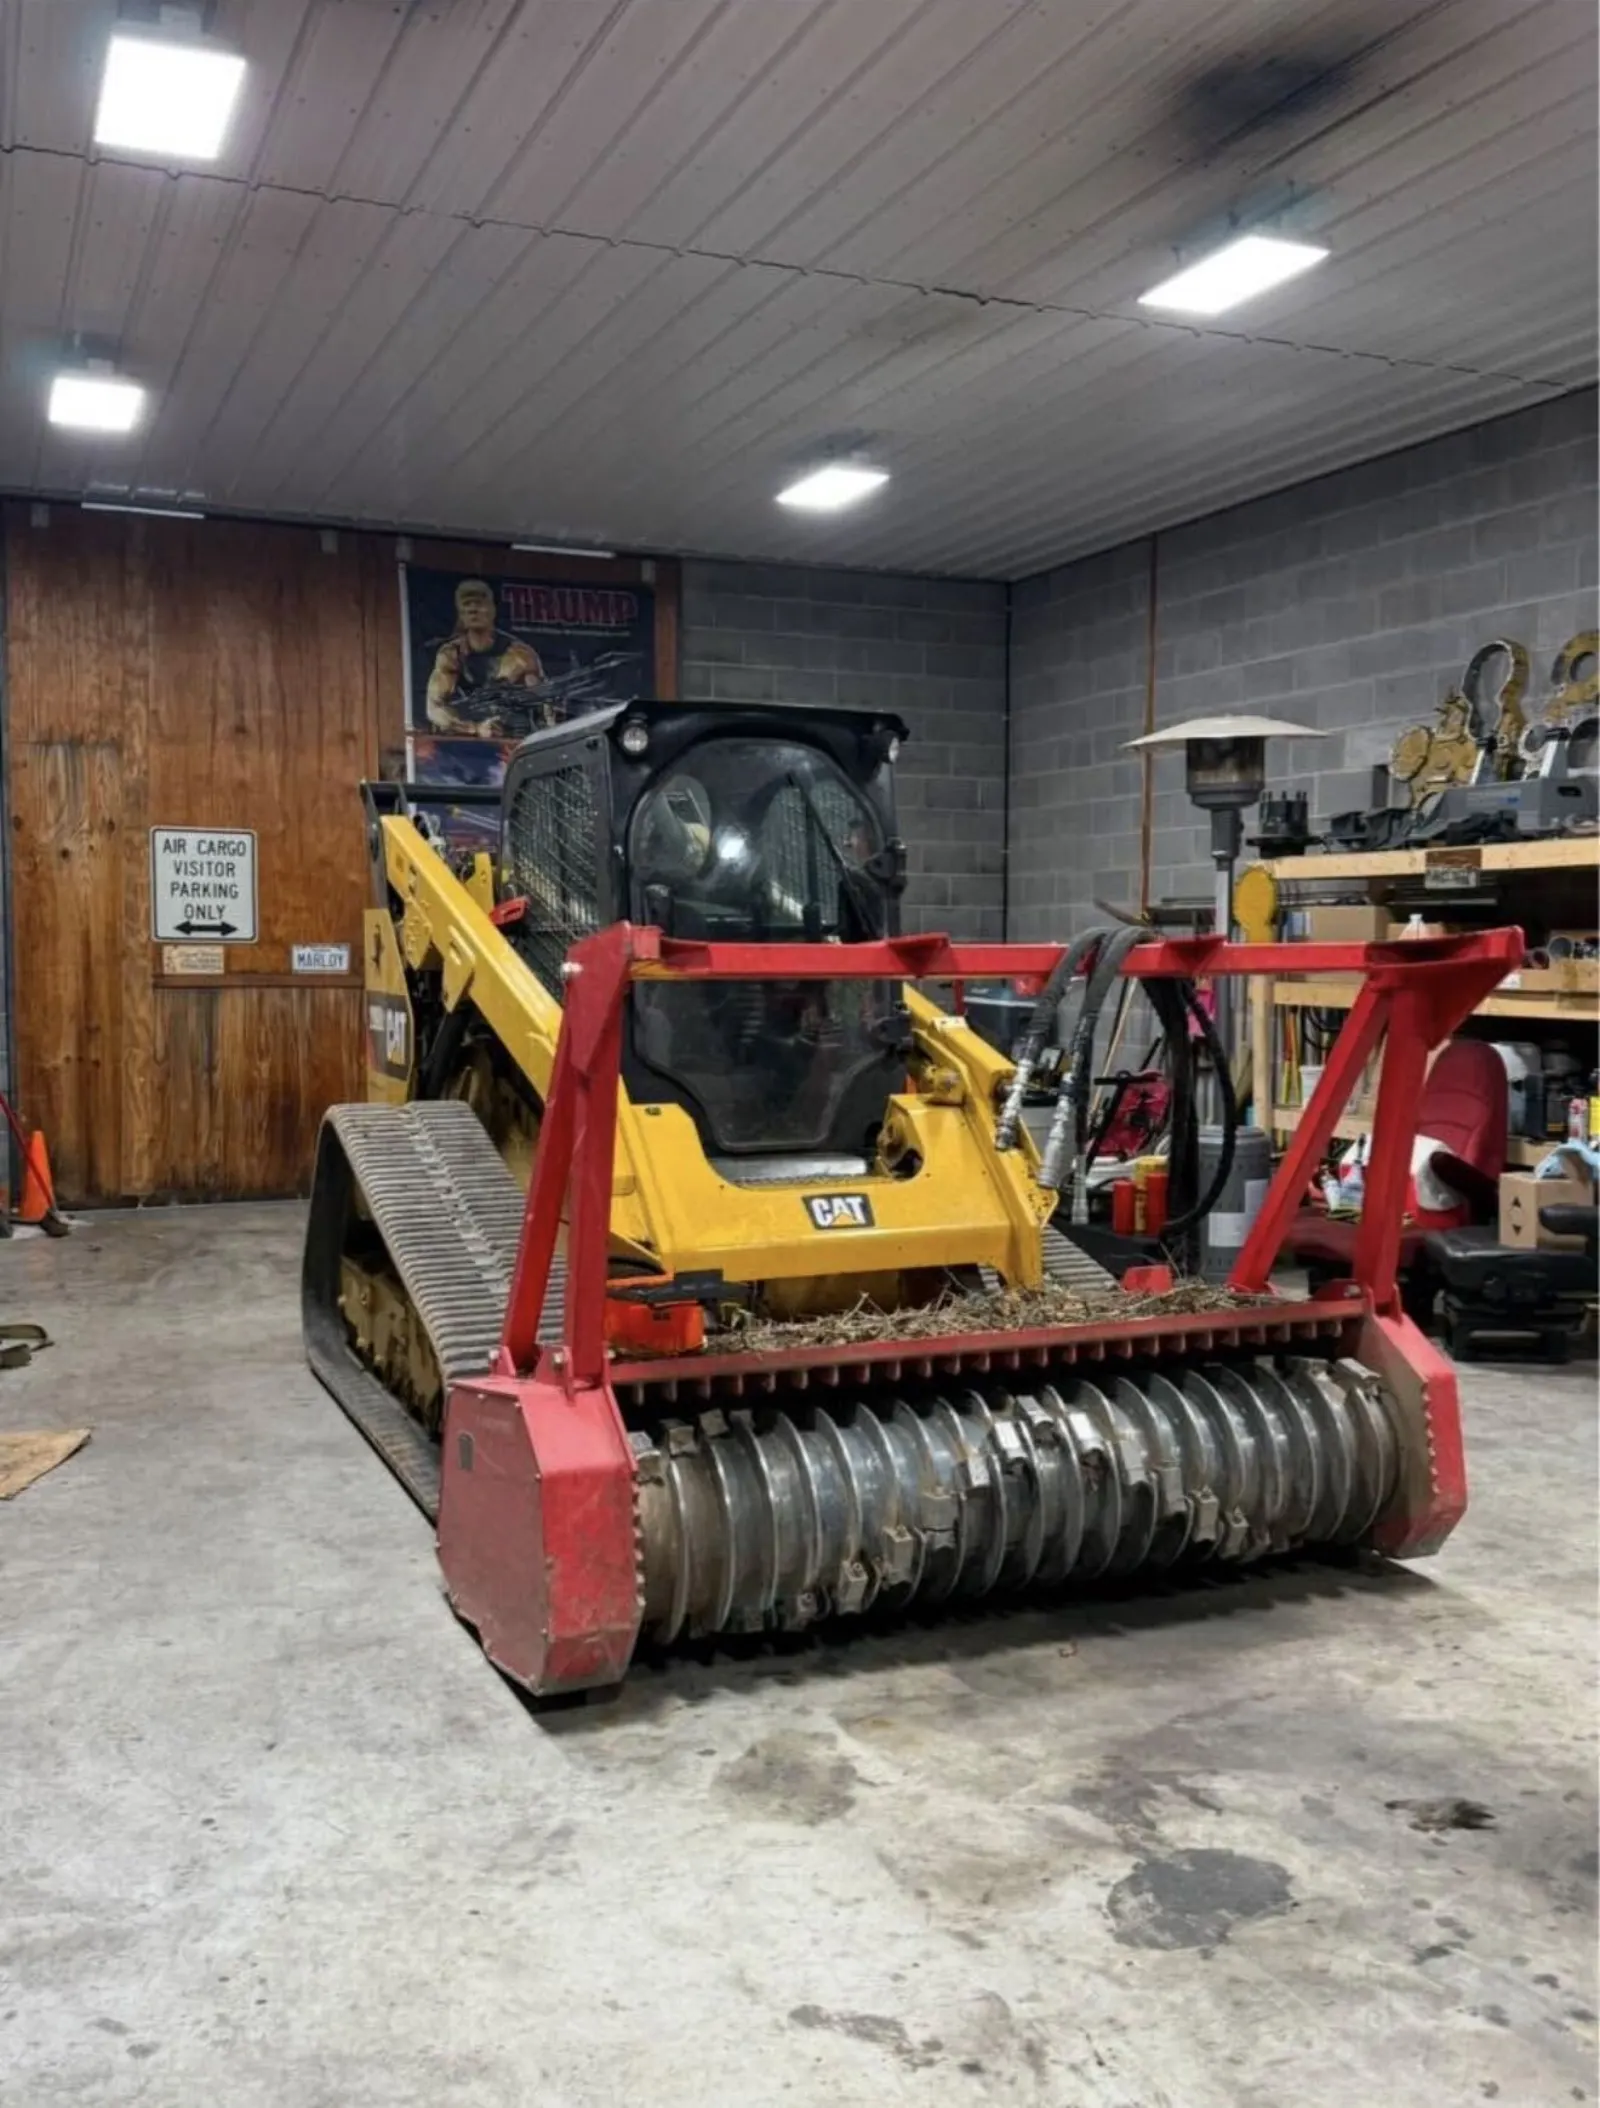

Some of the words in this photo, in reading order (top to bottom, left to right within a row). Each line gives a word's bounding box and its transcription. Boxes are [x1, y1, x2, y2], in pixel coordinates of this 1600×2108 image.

[502, 583, 638, 626] TRUMP
[163, 838, 186, 854] AIR
[197, 839, 247, 857] CARGO
[173, 860, 236, 877] VISITOR
[170, 881, 239, 899] PARKING
[184, 903, 225, 920] ONLY
[810, 1196, 866, 1226] CAT
